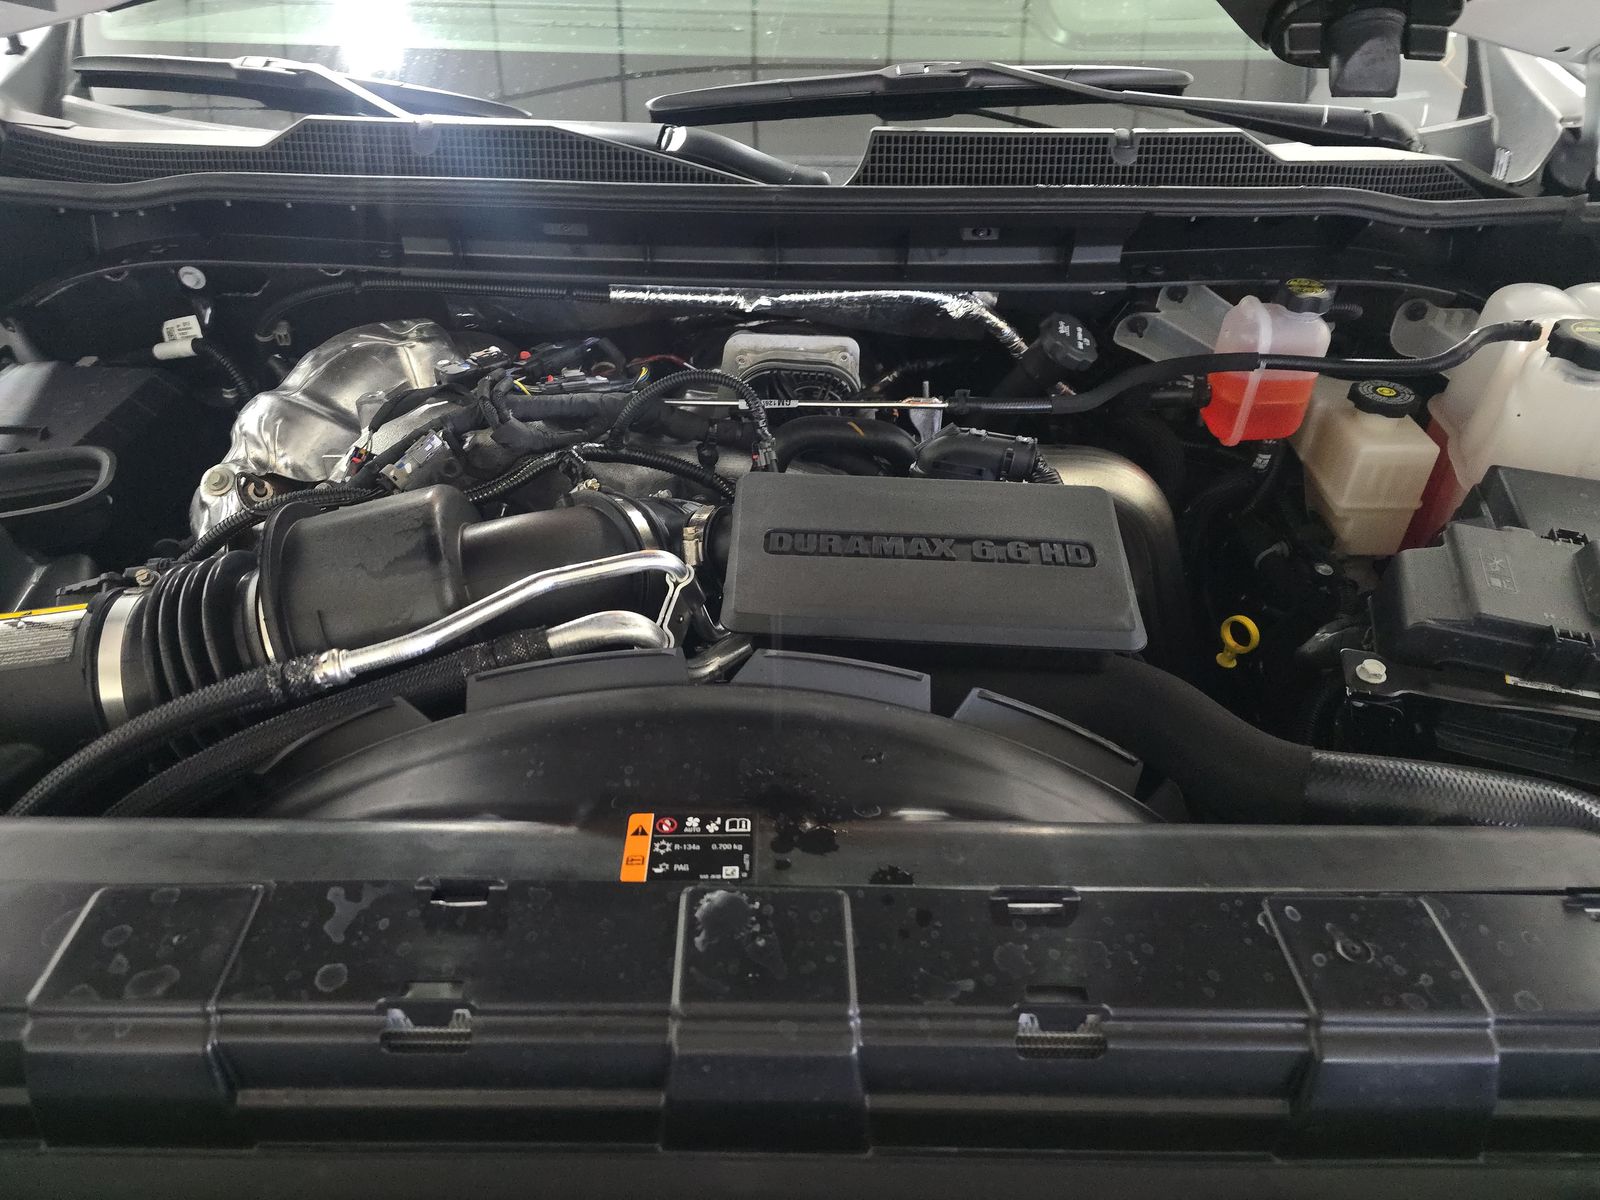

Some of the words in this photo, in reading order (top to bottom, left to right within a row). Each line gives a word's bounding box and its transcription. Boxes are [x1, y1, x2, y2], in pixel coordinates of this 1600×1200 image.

[768, 531, 956, 561] DURAMAX
[971, 539, 1030, 564] 6.6
[1040, 542, 1093, 566] HD
[733, 843, 743, 851] kg
